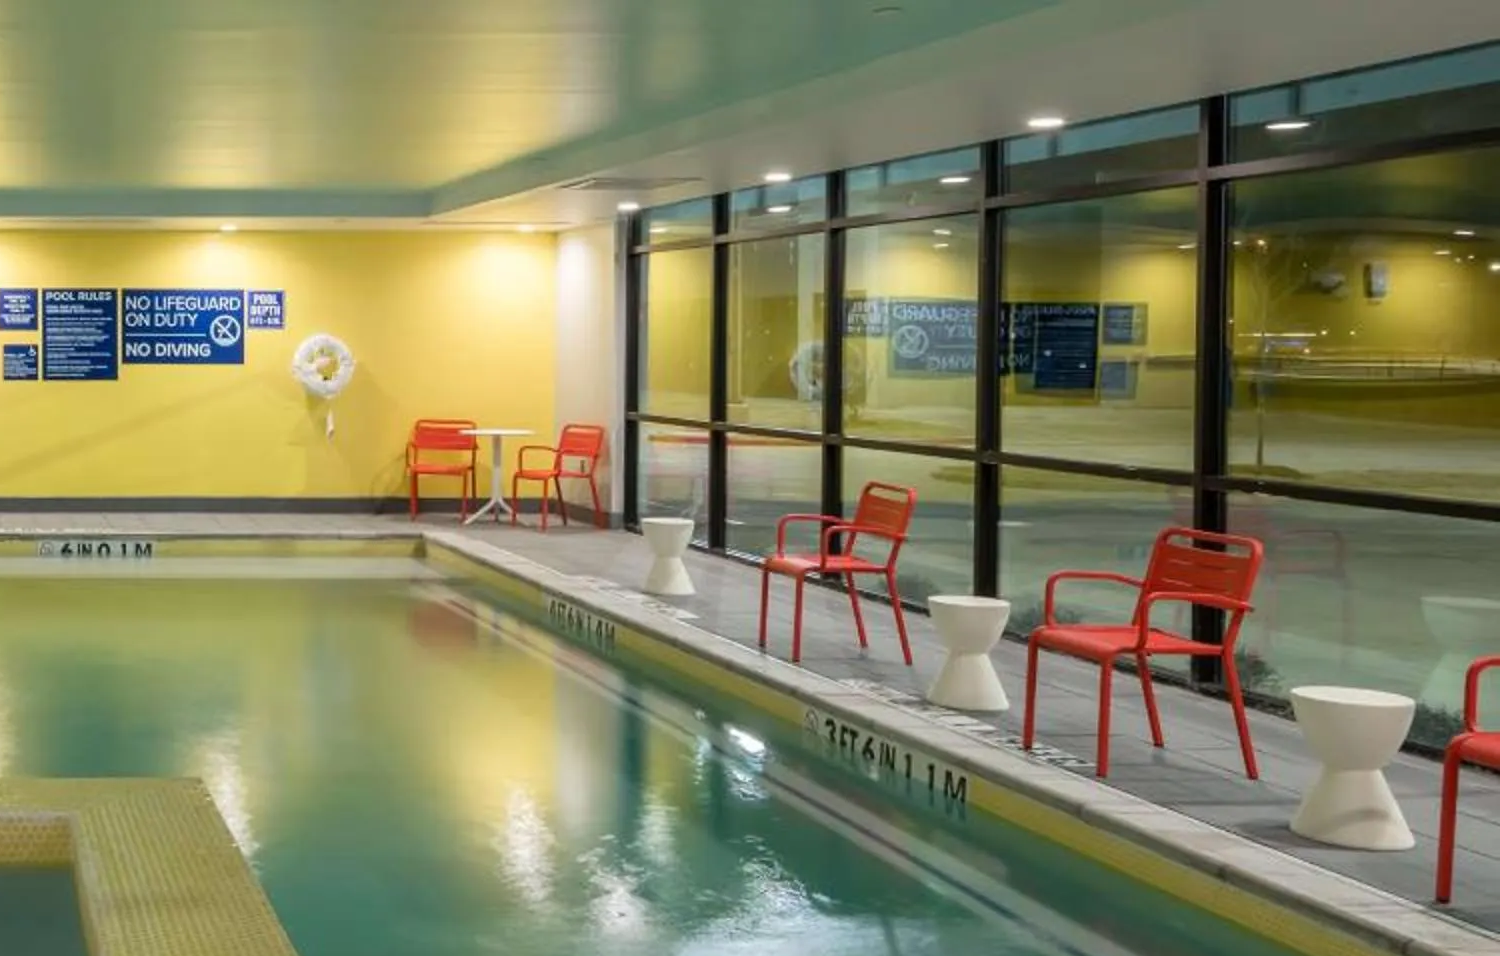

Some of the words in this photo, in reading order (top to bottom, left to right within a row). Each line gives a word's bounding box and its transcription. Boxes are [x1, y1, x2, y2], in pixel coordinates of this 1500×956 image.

[46, 291, 75, 301] POOL
[78, 291, 112, 301] RULES
[253, 294, 278, 304] POOL
[125, 296, 150, 311] NO
[155, 296, 241, 311] LIFEGUARD
[125, 313, 149, 327] ON
[155, 313, 198, 327] DUTY
[125, 343, 150, 357] NO
[155, 343, 211, 357] DIVING
